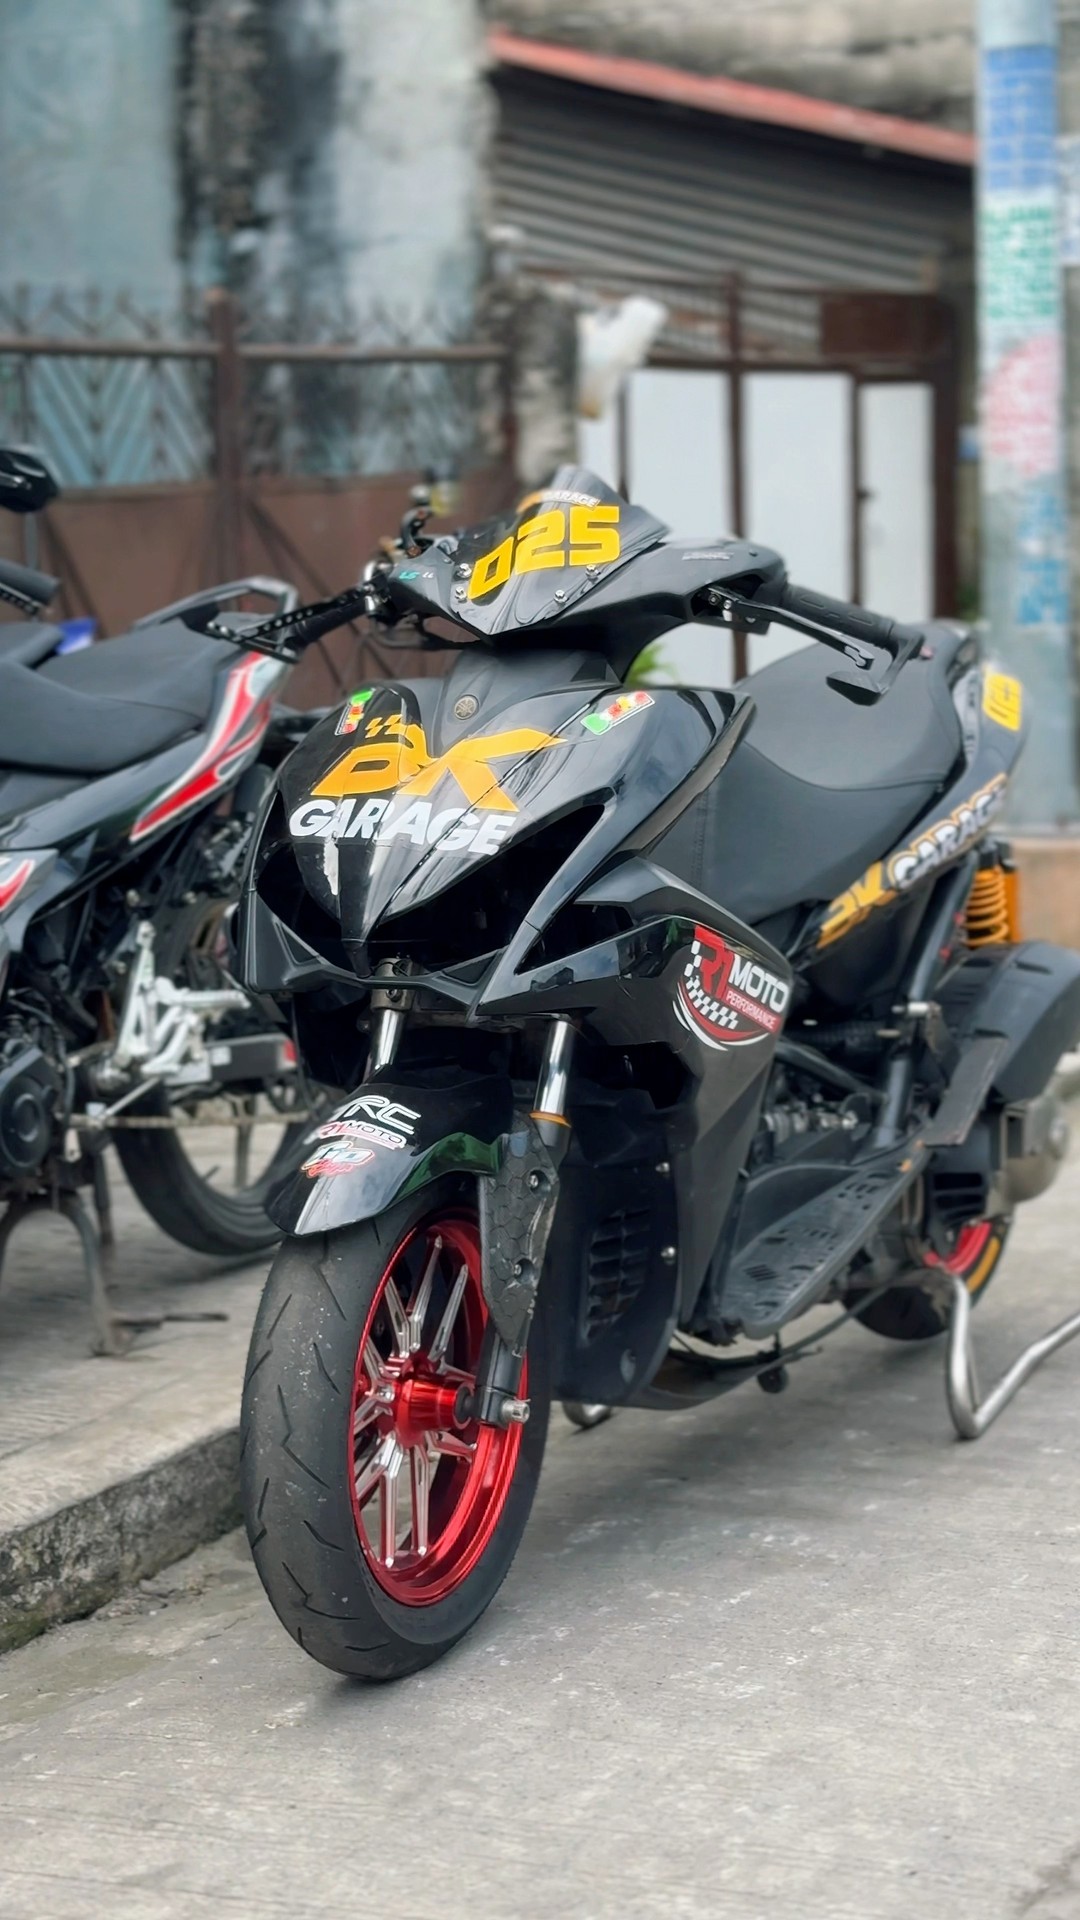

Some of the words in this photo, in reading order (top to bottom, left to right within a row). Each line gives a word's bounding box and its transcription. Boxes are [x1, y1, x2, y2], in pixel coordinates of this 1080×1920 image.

[468, 505, 619, 600] 025
[310, 714, 568, 812] BK
[289, 798, 518, 855] GARAGE
[726, 991, 777, 1030] PERFORMANCE
[728, 953, 790, 1013] MOTO
